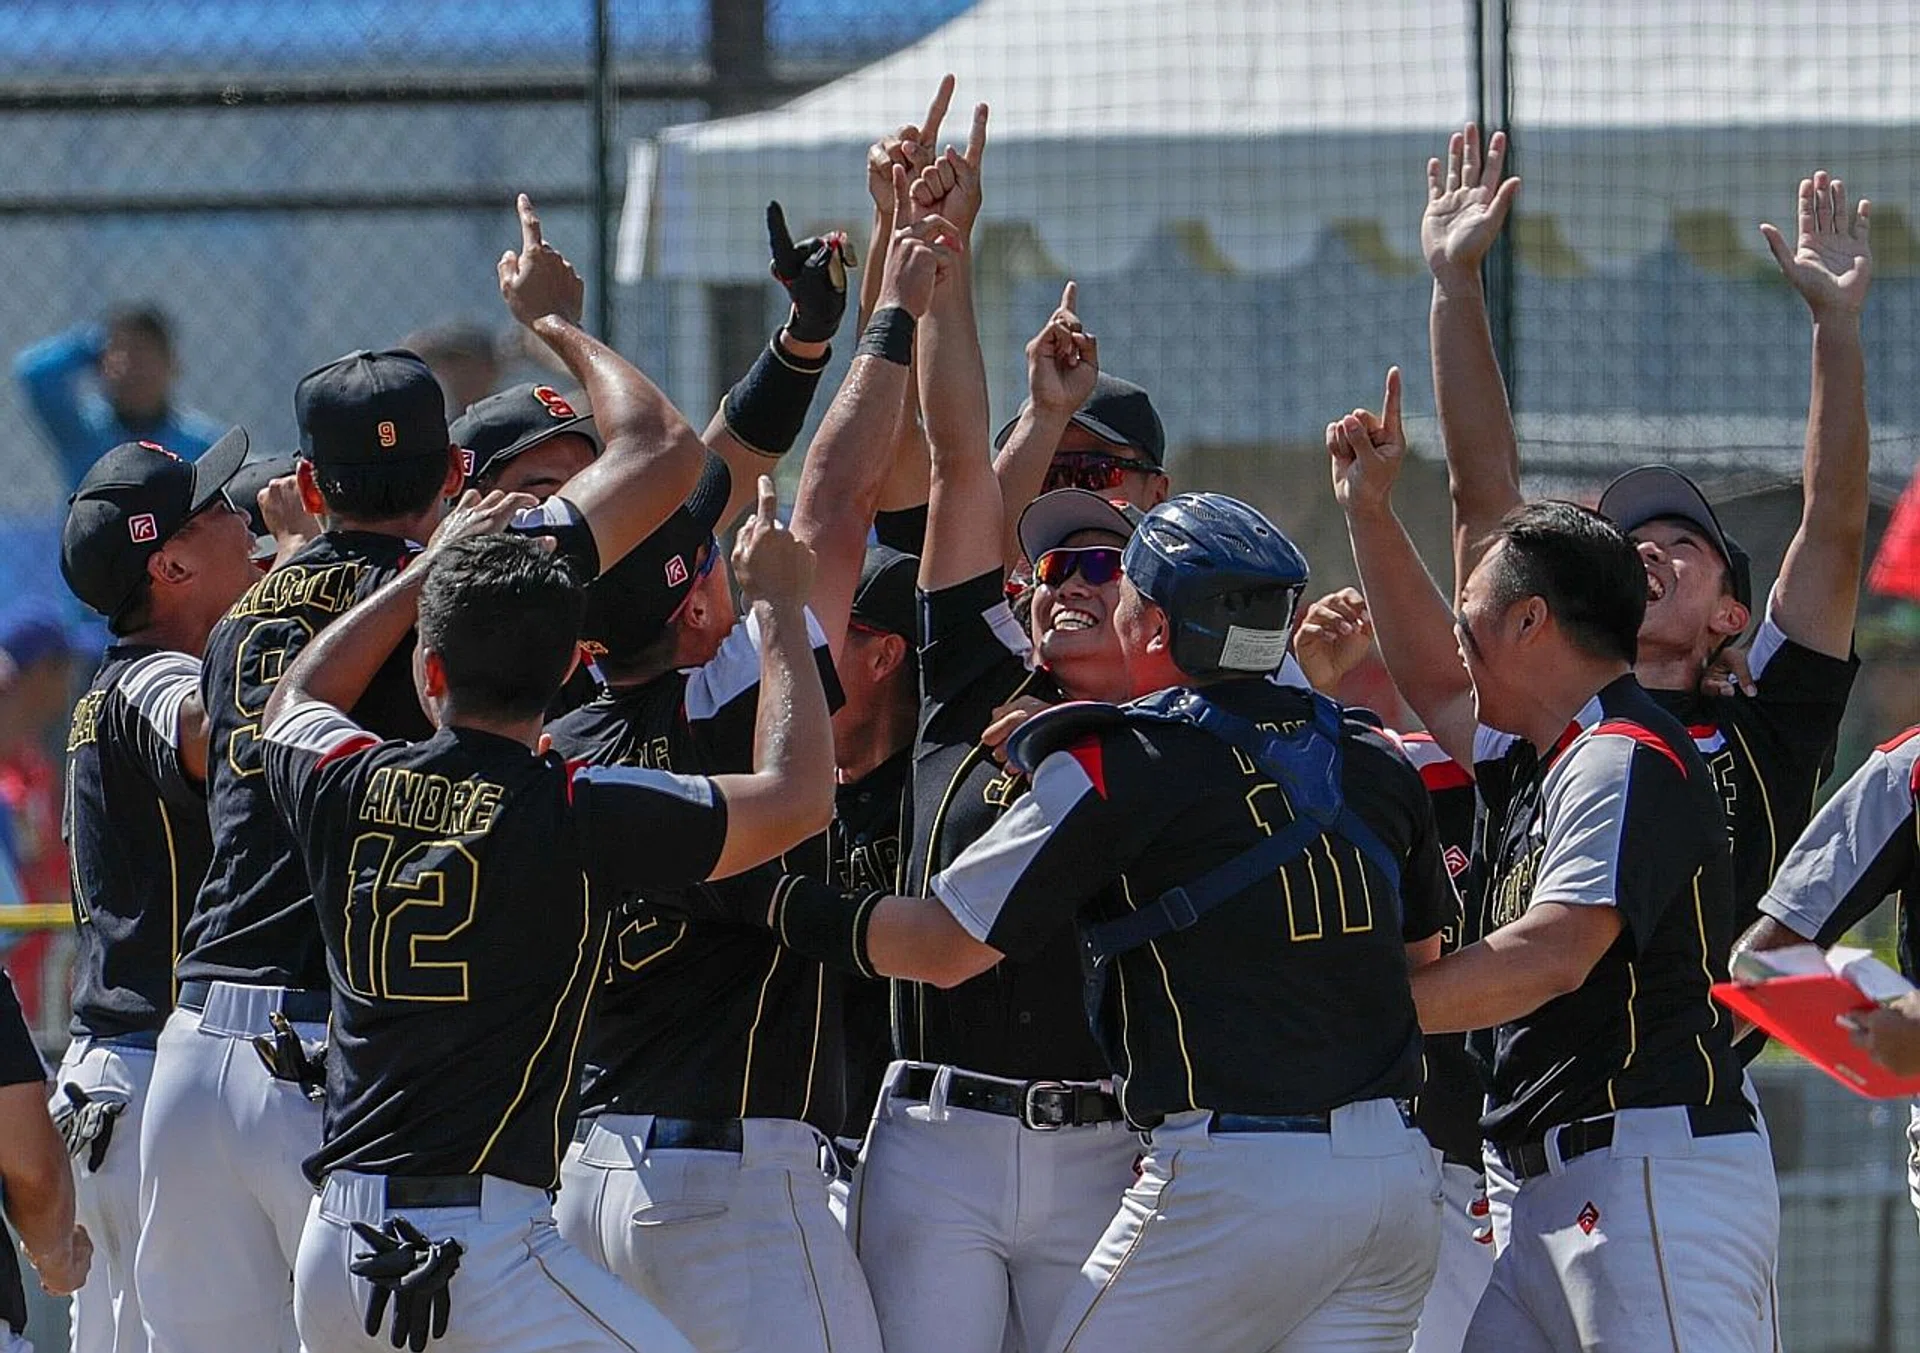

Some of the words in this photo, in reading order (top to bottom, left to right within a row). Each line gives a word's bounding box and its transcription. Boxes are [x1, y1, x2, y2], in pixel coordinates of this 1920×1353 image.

[533, 385, 575, 418] S
[377, 420, 397, 447] 9
[344, 831, 479, 1002] 12
